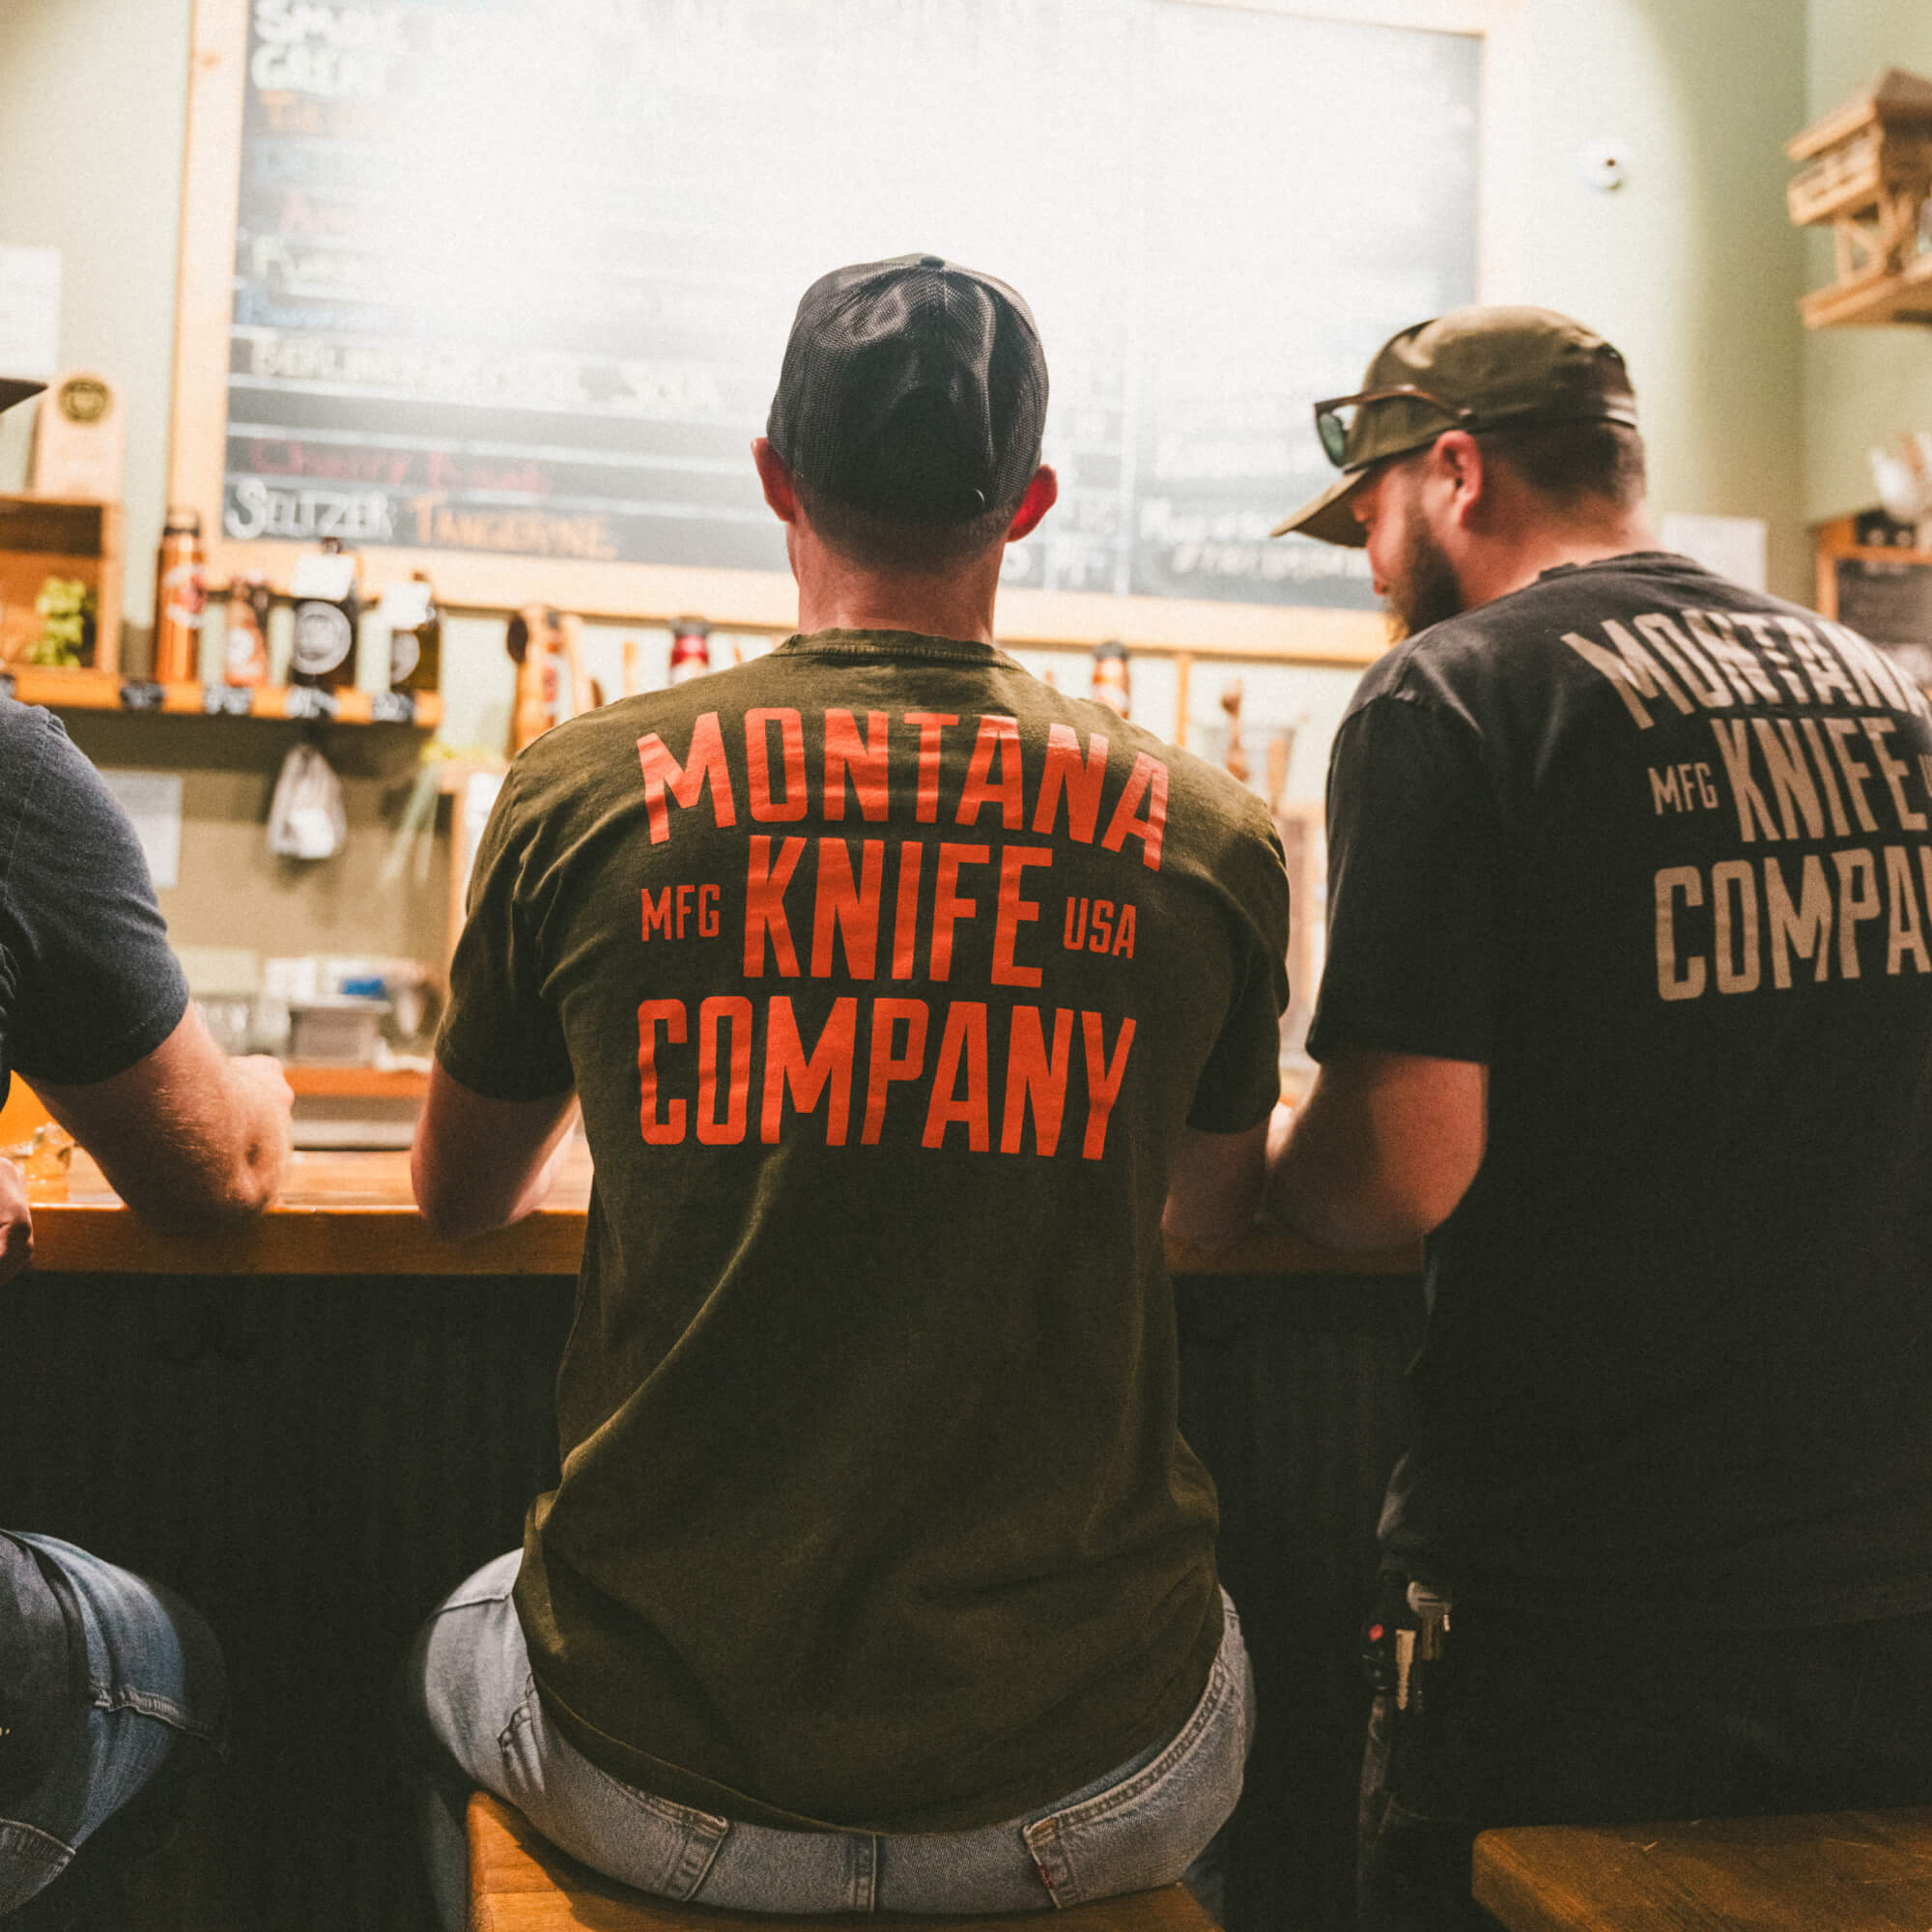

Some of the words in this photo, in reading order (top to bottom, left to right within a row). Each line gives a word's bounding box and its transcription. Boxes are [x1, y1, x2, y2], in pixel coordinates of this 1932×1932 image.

[637, 707, 1169, 871] MONTANA
[1648, 763, 1719, 815] MFG
[1709, 717, 1928, 842] KNIFE
[640, 884, 721, 942] MFG
[743, 835, 1053, 988] KNIFE
[1063, 896, 1137, 959] USA
[1653, 845, 1932, 1002] COMPA
[638, 995, 1137, 1161] COMPANY
